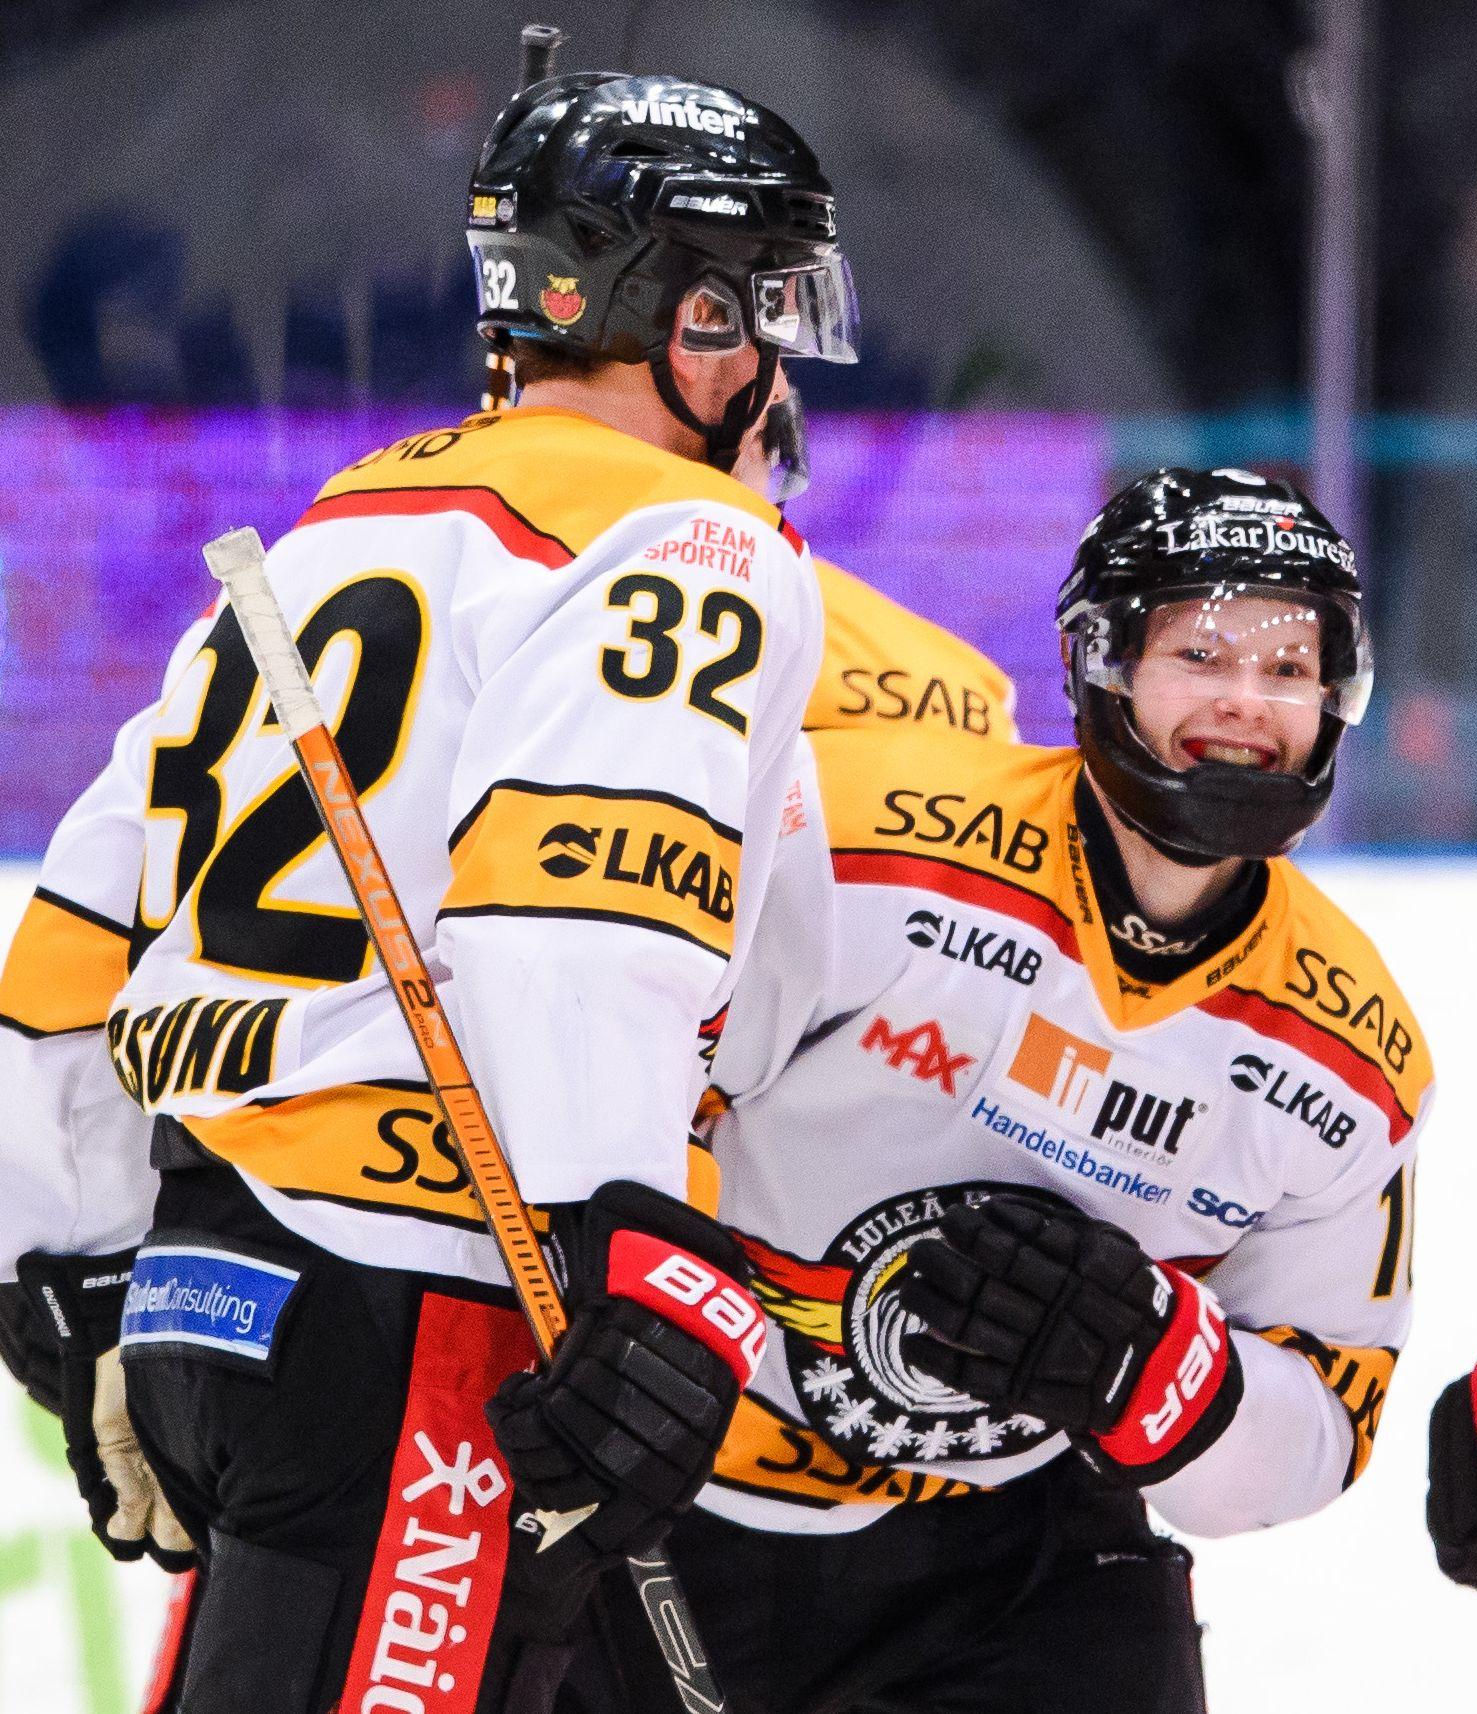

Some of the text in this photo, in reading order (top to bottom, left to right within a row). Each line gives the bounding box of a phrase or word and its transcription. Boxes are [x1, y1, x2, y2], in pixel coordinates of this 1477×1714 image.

[482, 259, 519, 310] 32
[643, 543, 752, 582] SPORTIA
[690, 518, 757, 558] TEAM
[599, 572, 766, 740] 32
[837, 668, 991, 736] SSAB
[873, 789, 1050, 874] SSAB
[602, 826, 735, 924] LKAB
[939, 919, 1043, 986] LKAB
[1285, 947, 1414, 1075] SSAB
[859, 1013, 976, 1098] MAX
[970, 1096, 1173, 1206] Handelsbanken
[1263, 1069, 1357, 1150] LKAB
[360, 1107, 479, 1200] SS
[841, 1190, 946, 1264] LULEÅ
[1140, 1270, 1226, 1445] UER
